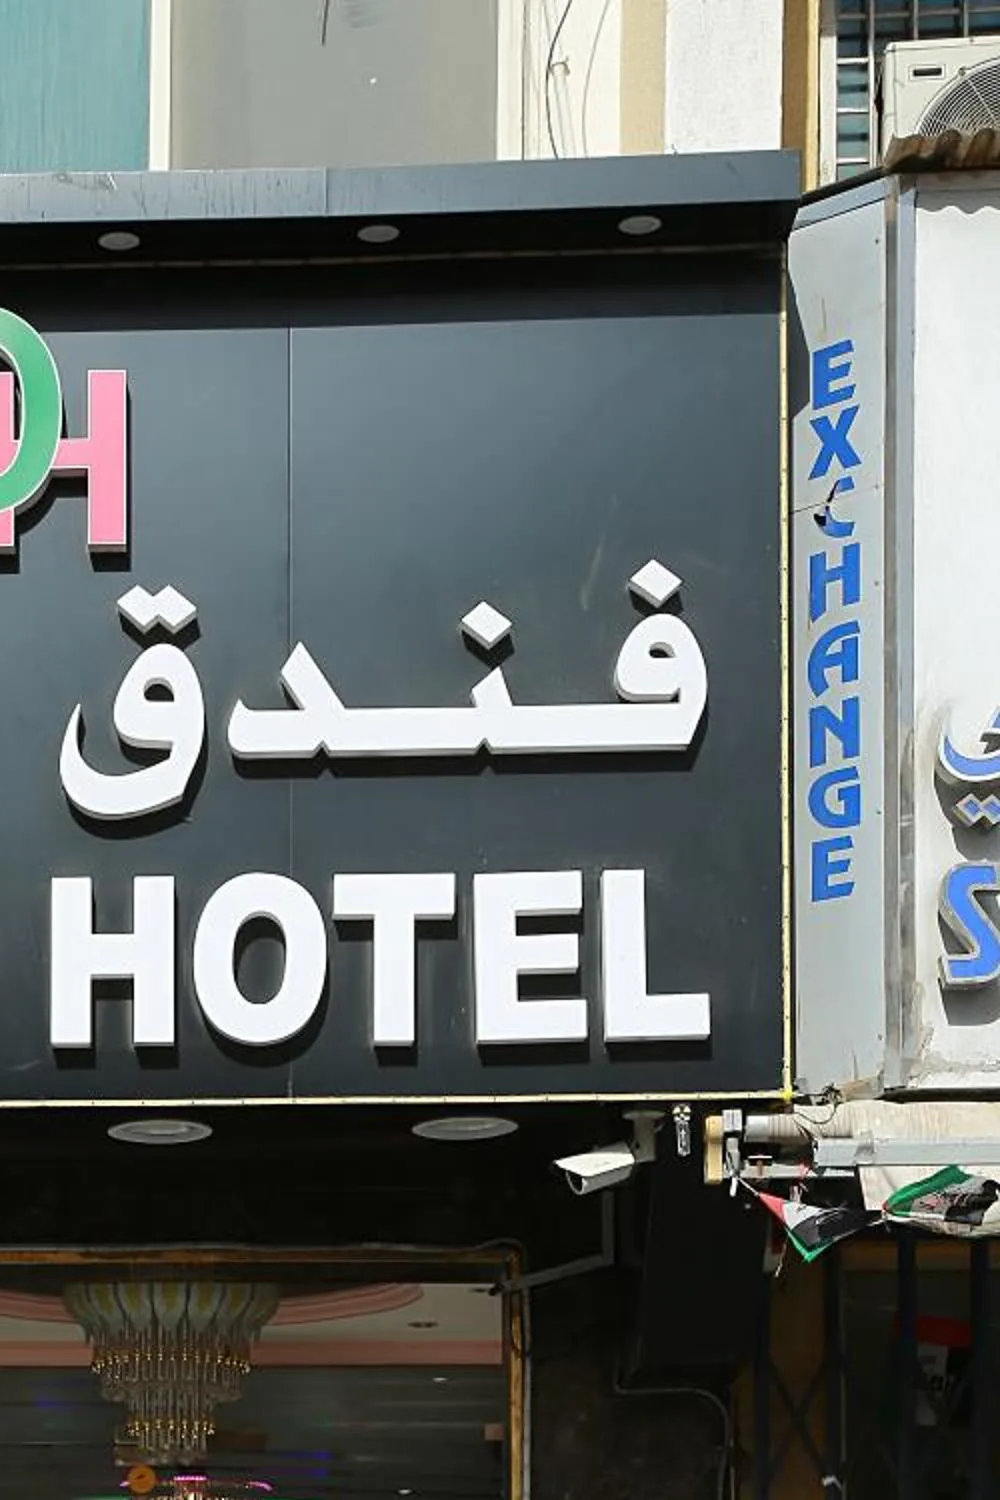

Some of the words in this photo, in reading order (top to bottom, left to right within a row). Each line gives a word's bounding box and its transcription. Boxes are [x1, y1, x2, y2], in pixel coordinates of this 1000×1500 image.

[58, 558, 709, 822] فندق
[807, 339, 862, 903] EXCHANGE
[49, 868, 712, 1050] HOTEL
